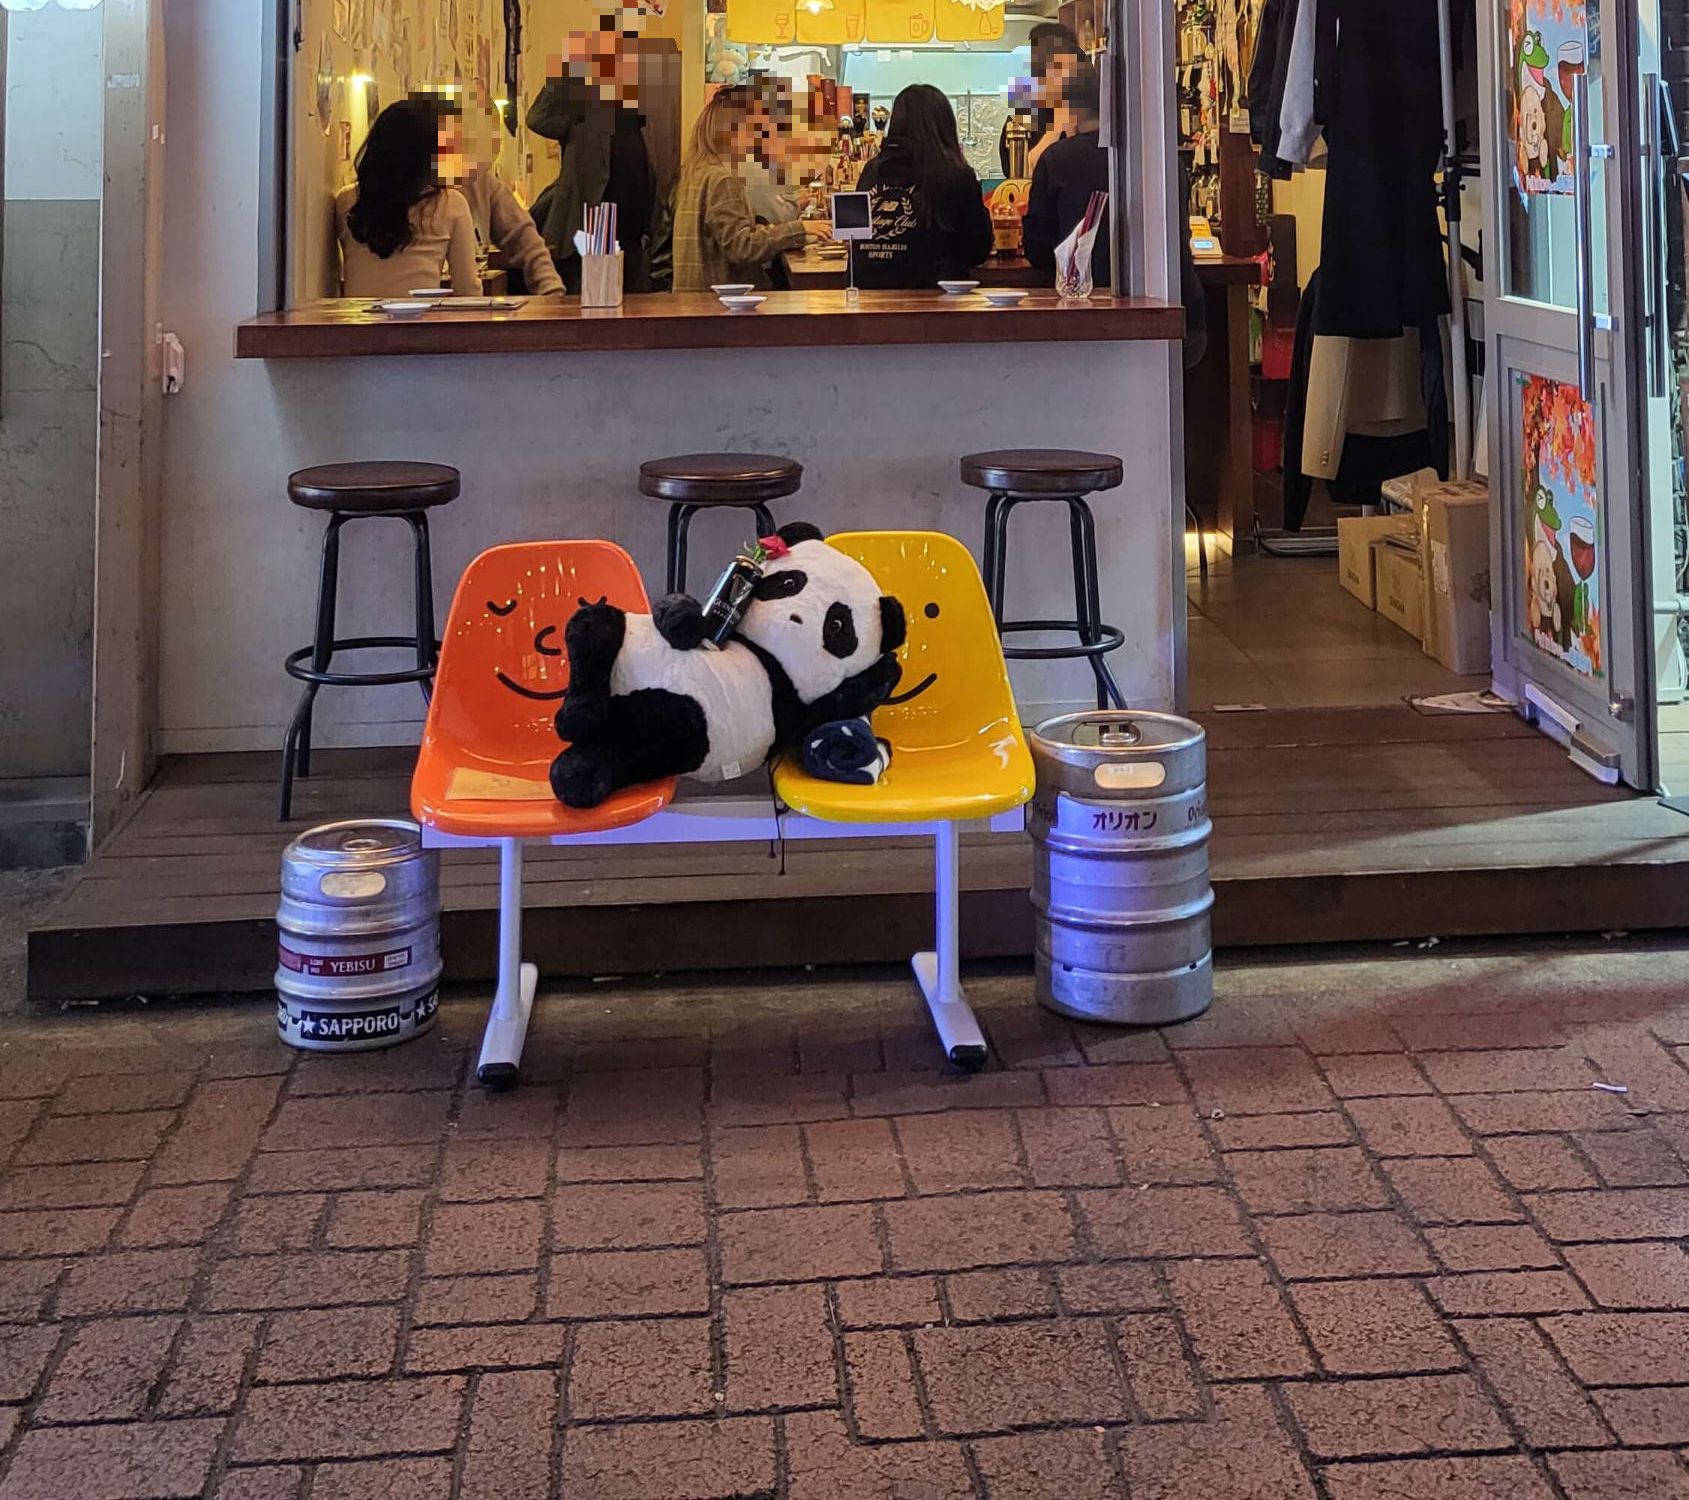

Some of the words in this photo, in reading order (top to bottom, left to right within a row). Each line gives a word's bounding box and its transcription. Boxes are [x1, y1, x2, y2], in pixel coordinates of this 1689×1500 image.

[1093, 811, 1157, 831] オリオン
[330, 958, 376, 973] YEBISU
[319, 1012, 398, 1036] SAPPORO
